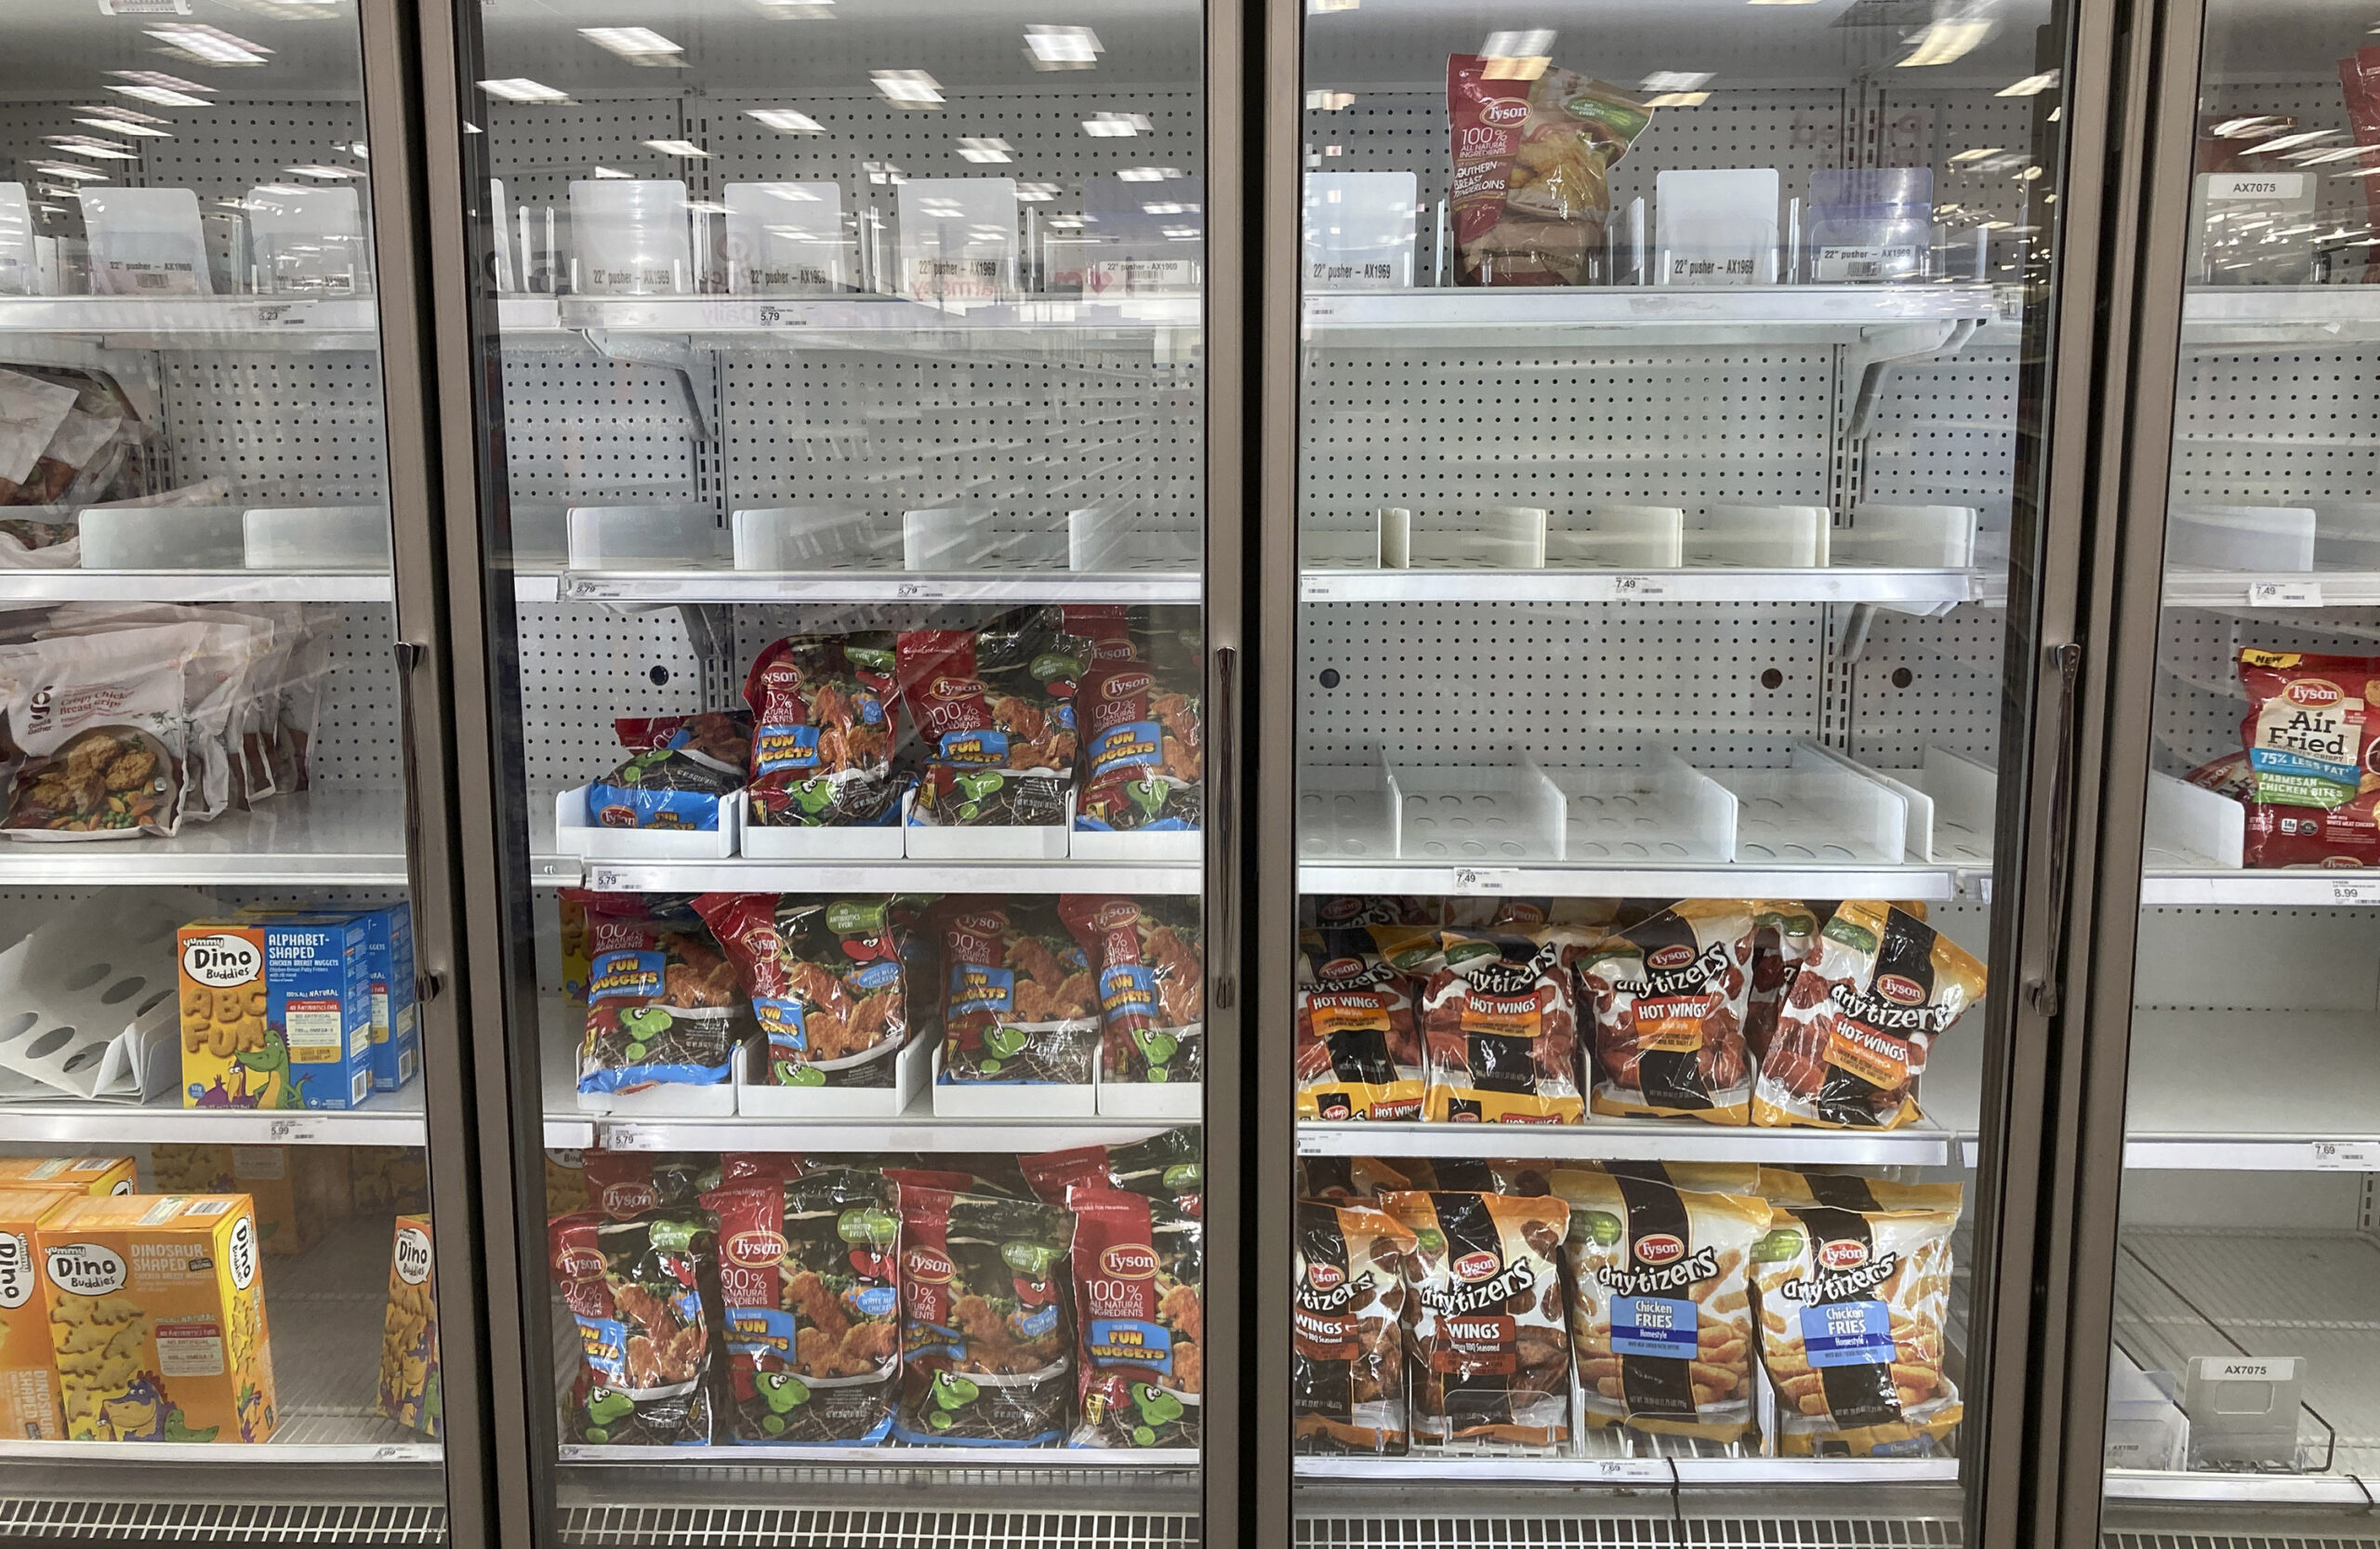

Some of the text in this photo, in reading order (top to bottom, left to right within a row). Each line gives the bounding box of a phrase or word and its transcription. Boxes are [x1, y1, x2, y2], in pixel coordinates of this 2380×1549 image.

[1488, 106, 1527, 122] Tyson
[1462, 127, 1507, 145] 100%
[1475, 142, 1506, 151] NATURAL
[1460, 150, 1506, 158] INGREDIENTS
[2233, 183, 2276, 192] AX7075
[1824, 250, 1839, 258] 22"
[1841, 250, 1868, 259] pusher
[919, 260, 997, 276] 22" pusher AX1969
[1107, 262, 1177, 272] 22" pusher AX1969
[1313, 263, 1391, 281] 22" pusher AX1969
[1674, 259, 1754, 277] 22" pusher AX1969
[592, 270, 605, 284] 22"
[608, 271, 631, 286] pusher
[750, 271, 762, 284] 22"
[765, 271, 788, 285] pusher
[760, 312, 779, 321] 5.79
[1616, 579, 1635, 588] 7.49
[2255, 586, 2276, 595] 7.49
[1092, 647, 1131, 659] Tyson
[2255, 653, 2283, 665] NEW
[940, 681, 982, 695] Tyson
[1108, 677, 1150, 695] Tyson
[2293, 685, 2338, 703] Tyson
[60, 703, 92, 714] Breast
[1103, 709, 1136, 722] NATURAL
[2289, 711, 2336, 734] Air
[761, 735, 795, 748] FUN
[1104, 732, 1135, 748] FUN
[2268, 727, 2345, 755] Fried
[947, 741, 981, 755] FUN
[1091, 742, 1155, 769] NUGGETS
[2261, 752, 2320, 770] 75% LESS
[2262, 774, 2318, 786] PARMESAN
[2259, 782, 2307, 796] CHICKEN
[598, 876, 616, 884] 5.79
[1458, 874, 1475, 882] 7.49
[2334, 889, 2358, 897] 8.99
[829, 914, 861, 923] ANTIBIOTICS
[183, 937, 224, 948] yummy
[269, 933, 329, 946] ALPHABET-
[606, 935, 643, 944] NATURAL
[747, 937, 777, 956] Tyson
[193, 947, 252, 970] Dino
[269, 947, 315, 959] SHAPED
[1655, 950, 1690, 965] Tyson
[607, 959, 639, 973] FUN
[1325, 963, 1358, 976] Tyson
[206, 967, 250, 980] Buddies
[963, 973, 987, 986] FUN
[1109, 974, 1133, 992] FUN
[1885, 978, 1921, 999] Tyson
[1313, 997, 1380, 1010] HOT WINGS
[1470, 996, 1536, 1013] HOT WINGS
[1638, 1003, 1707, 1020] HOT WINGS
[1836, 1021, 1906, 1061] HOT WINGS
[1374, 1106, 1394, 1118] HOT
[2315, 1145, 2335, 1154] 7.69
[20, 1233, 32, 1273] yummy
[45, 1246, 86, 1256] yummy
[236, 1225, 251, 1279] Dino
[399, 1240, 428, 1264] Dino
[735, 1238, 782, 1259] Tyson
[1641, 1242, 1679, 1259] Tyson
[1825, 1247, 1863, 1264] Tyson
[57, 1256, 117, 1278] Dino
[133, 1259, 186, 1272] SHAPED
[562, 1257, 602, 1277] Tyson
[909, 1251, 951, 1274] Tyson
[1107, 1252, 1154, 1271] Tyson
[1461, 1258, 1496, 1276] Tyson
[2, 1242, 20, 1299] Dino
[71, 1277, 115, 1289] Buddies
[731, 1289, 766, 1297] NATURAL
[1086, 1280, 1143, 1302] 100%
[1104, 1301, 1144, 1309] NATURAL
[1635, 1300, 1673, 1315] Chicken
[1090, 1309, 1144, 1317] INGREDIENTS
[1827, 1308, 1864, 1318] Chicken
[734, 1319, 767, 1333] FUN
[1297, 1314, 1342, 1334] WINGS
[1635, 1314, 1673, 1329] FRIES
[1828, 1320, 1867, 1335] FRIES
[1108, 1331, 1143, 1345] FUN
[1448, 1323, 1501, 1339] WINGS
[1640, 1330, 1668, 1340] Homestyle
[1318, 1335, 1342, 1344] Seasoned
[1091, 1345, 1166, 1359] NUGGETS
[1476, 1342, 1501, 1353] Seasoned
[2225, 1364, 2268, 1376] AX7075
[19, 1370, 38, 1419] SHAPED
